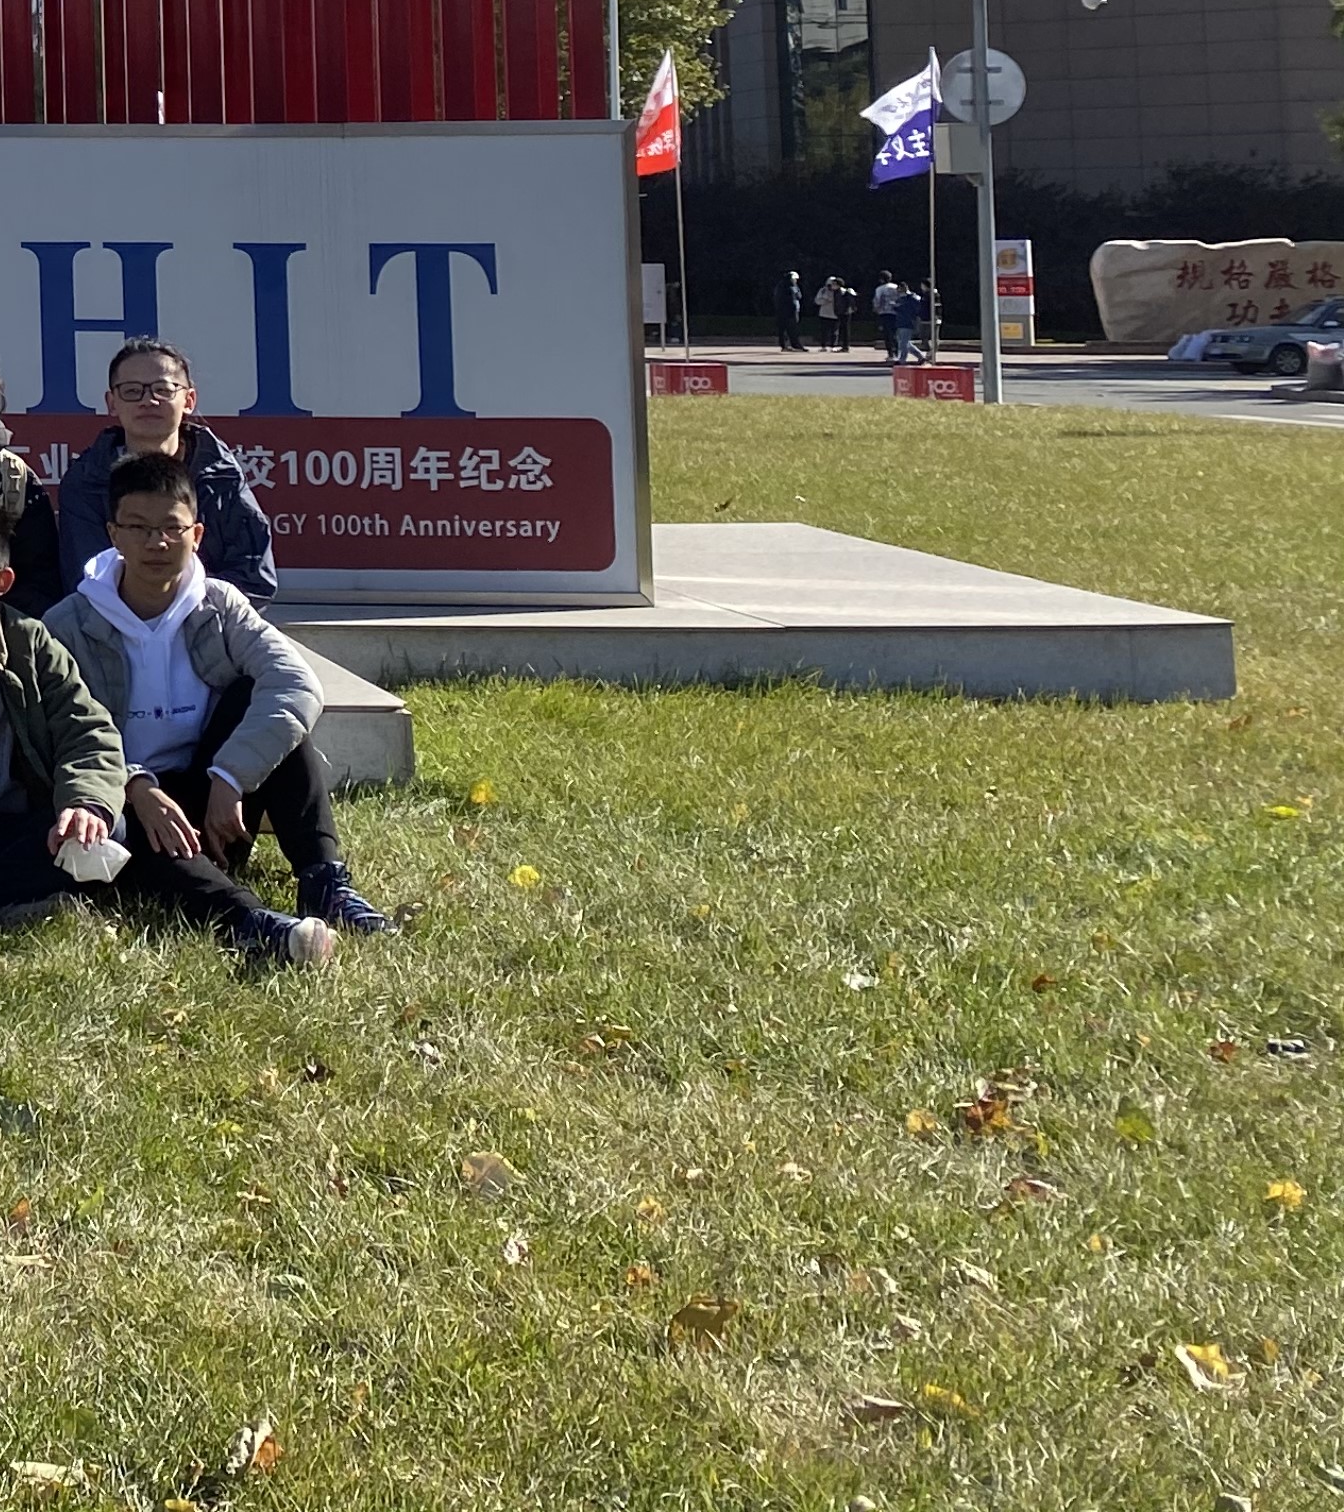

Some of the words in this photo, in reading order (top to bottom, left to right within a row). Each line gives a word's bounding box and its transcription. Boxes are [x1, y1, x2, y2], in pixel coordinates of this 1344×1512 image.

[20, 241, 498, 419] HIT
[317, 513, 390, 537] 100th
[400, 513, 561, 544] Anniversary
